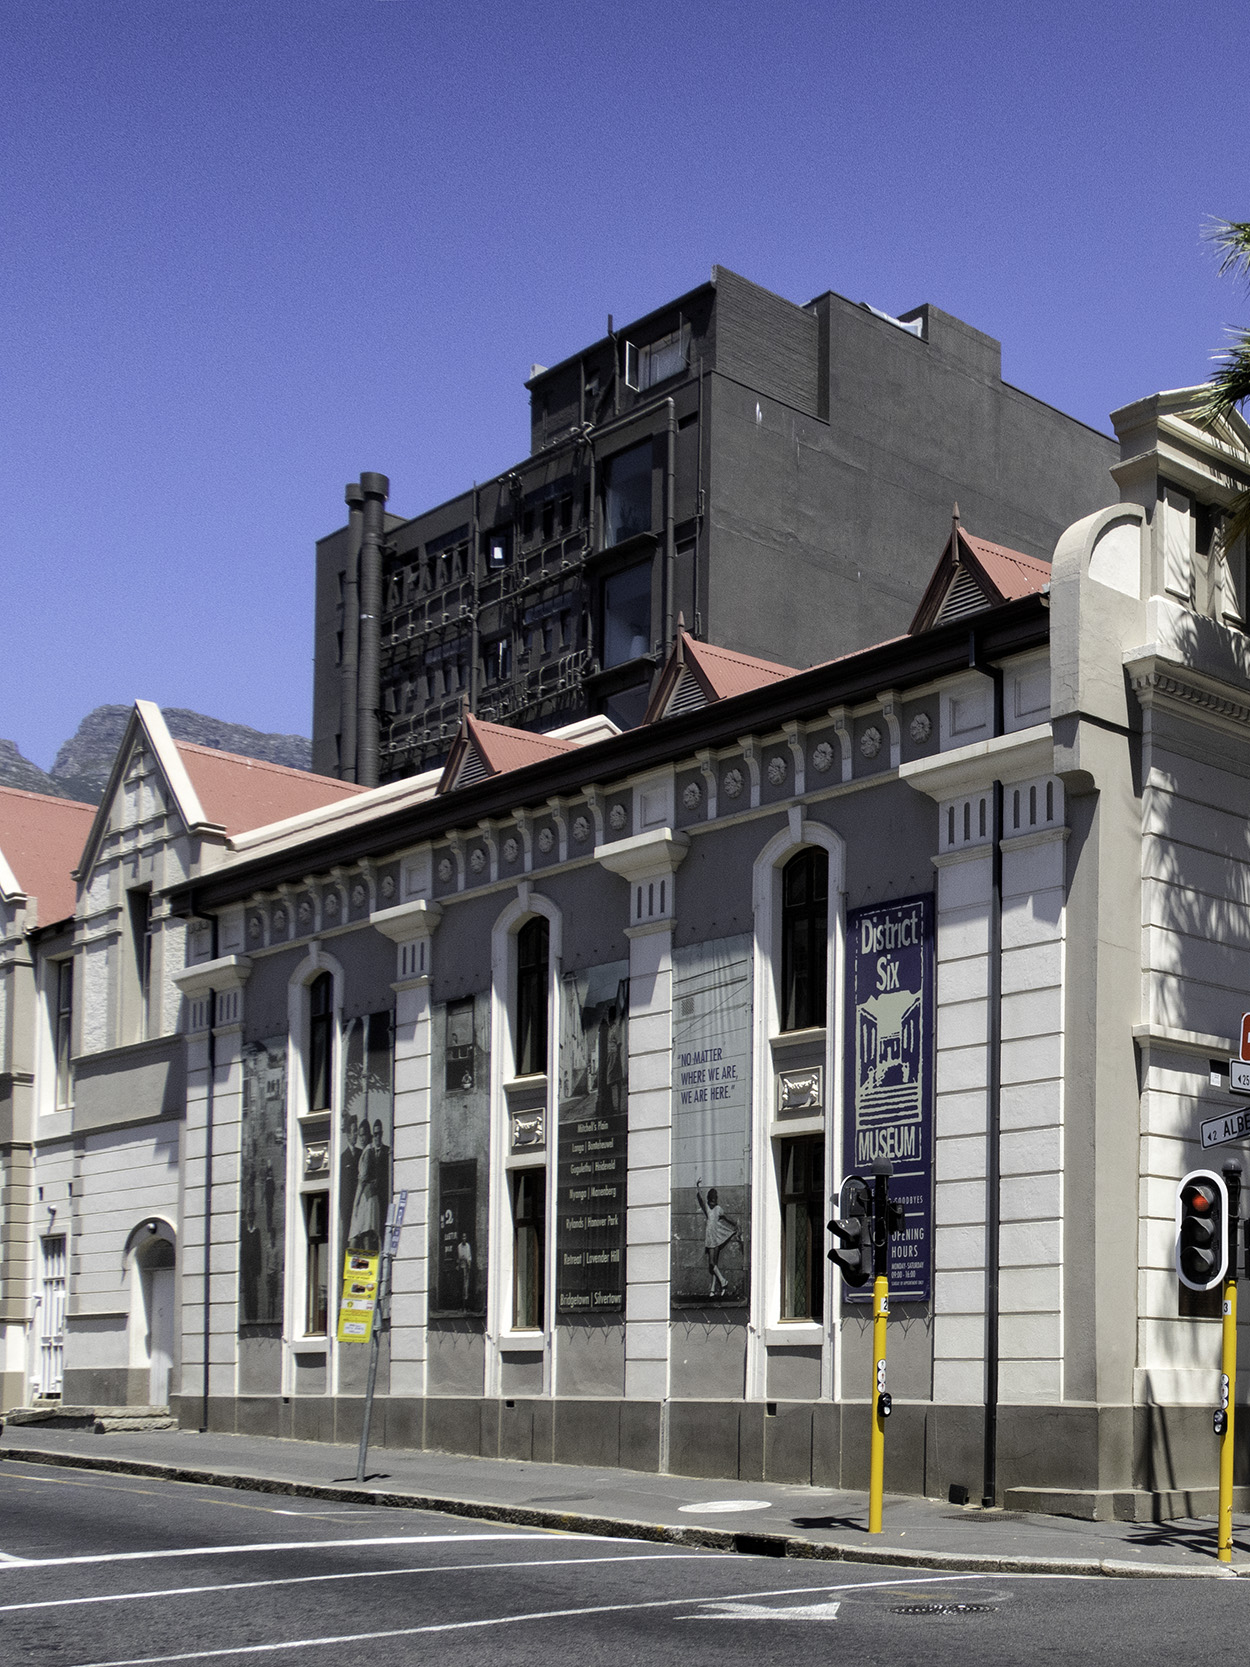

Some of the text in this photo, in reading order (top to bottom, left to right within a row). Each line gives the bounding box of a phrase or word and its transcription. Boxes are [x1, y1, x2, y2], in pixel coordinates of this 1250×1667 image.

[861, 910, 918, 954] District
[876, 955, 899, 991] Six
[693, 1048, 722, 1065] MATTER
[681, 1065, 738, 1085] WHERE WE ARE,
[1242, 1074, 1250, 1086] 25
[681, 1090, 692, 1104] WE
[694, 1088, 708, 1103] ARE
[598, 1120, 609, 1131] Plain
[858, 1125, 915, 1161] MUSEUM
[1213, 1130, 1217, 1140] 2
[569, 1184, 617, 1201] Nyanga Manenberg
[566, 1214, 618, 1231] Rylands Hanover Park
[891, 1228, 924, 1242] OPENING
[563, 1249, 620, 1265] Retreat Lavender Hill
[891, 1244, 918, 1258] HOURS
[560, 1291, 622, 1308] Bridgetown Silvertown
[1223, 1302, 1228, 1313] 3
